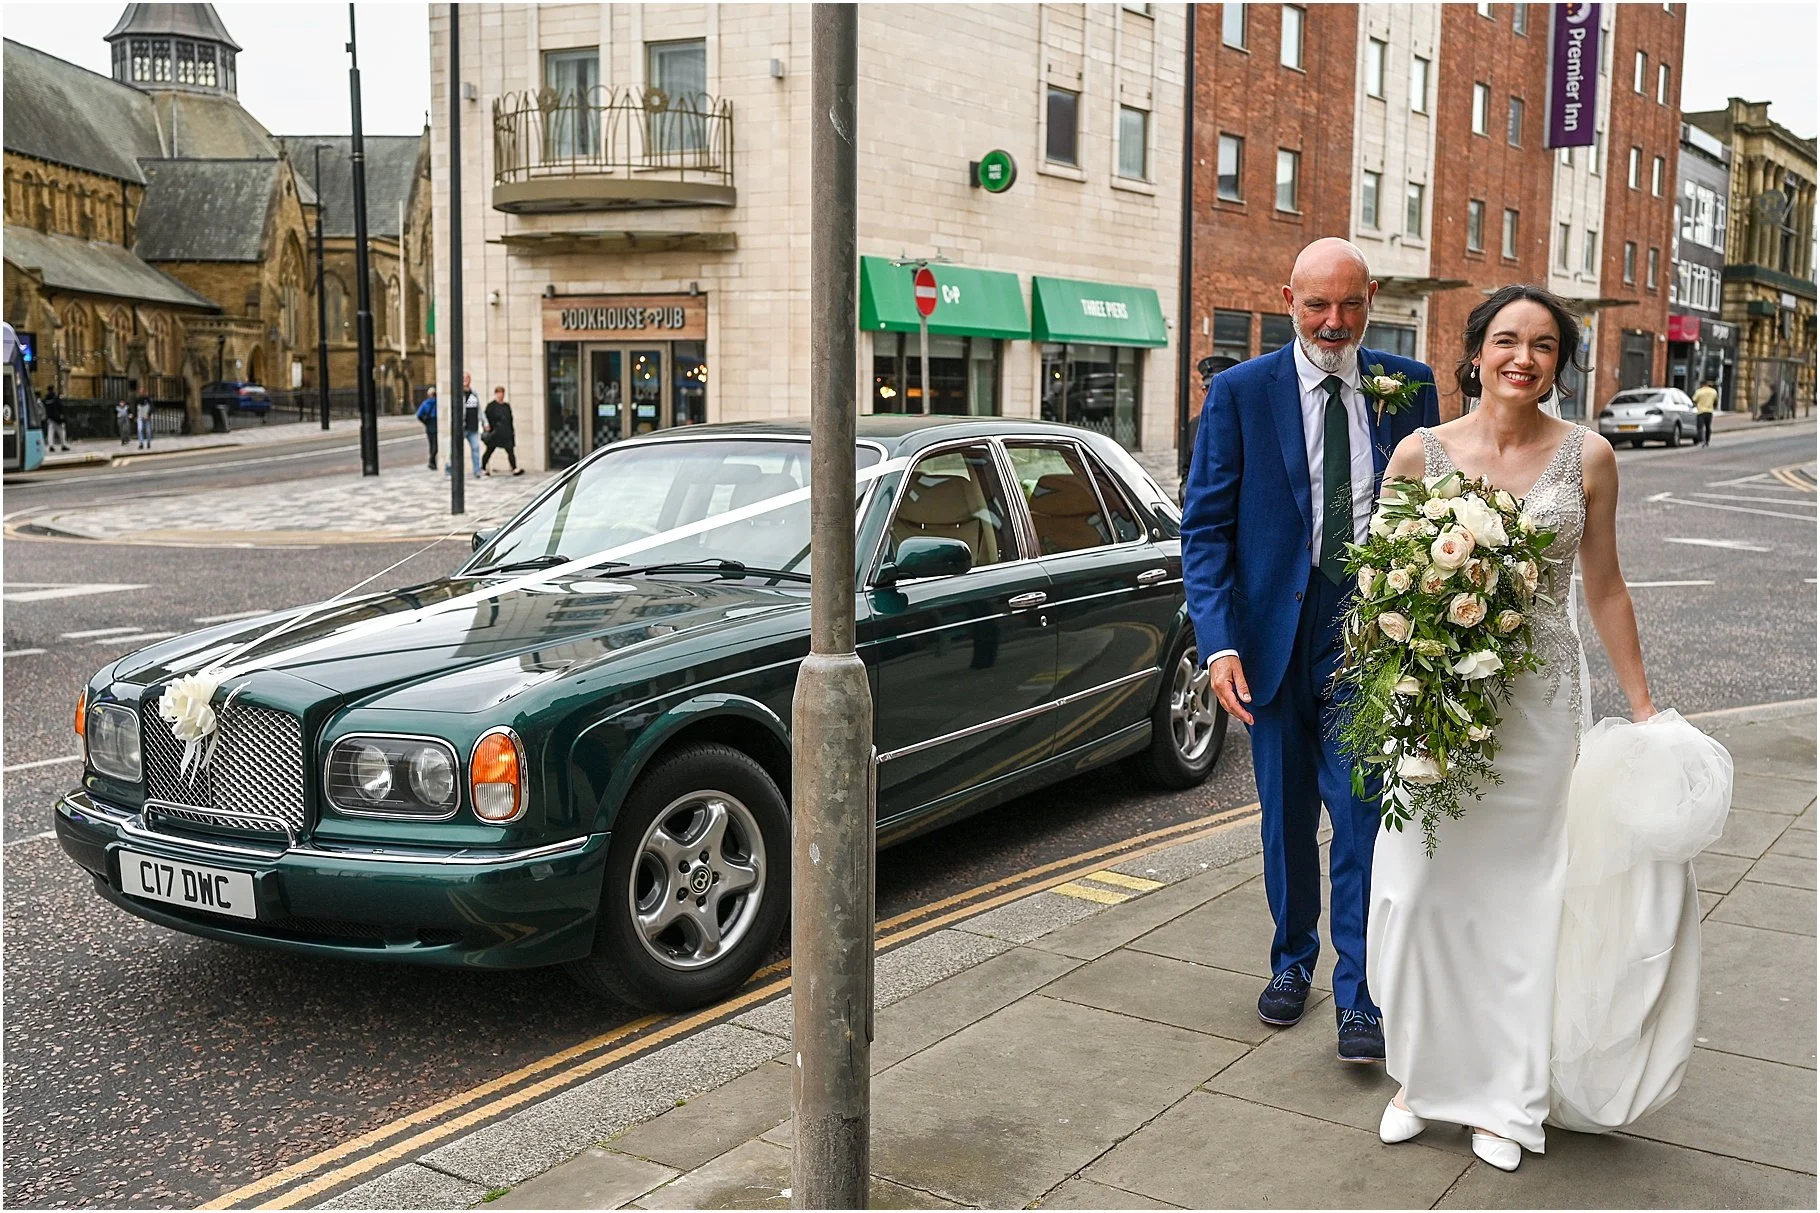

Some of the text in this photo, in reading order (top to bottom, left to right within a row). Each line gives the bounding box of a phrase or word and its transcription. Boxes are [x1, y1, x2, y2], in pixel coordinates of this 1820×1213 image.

[1563, 27, 1586, 132] Premier Inn
[560, 307, 645, 330] COOKHOUSE
[654, 307, 684, 328] PUB
[1080, 298, 1107, 317] THREE
[140, 861, 232, 909] C17 DWC
